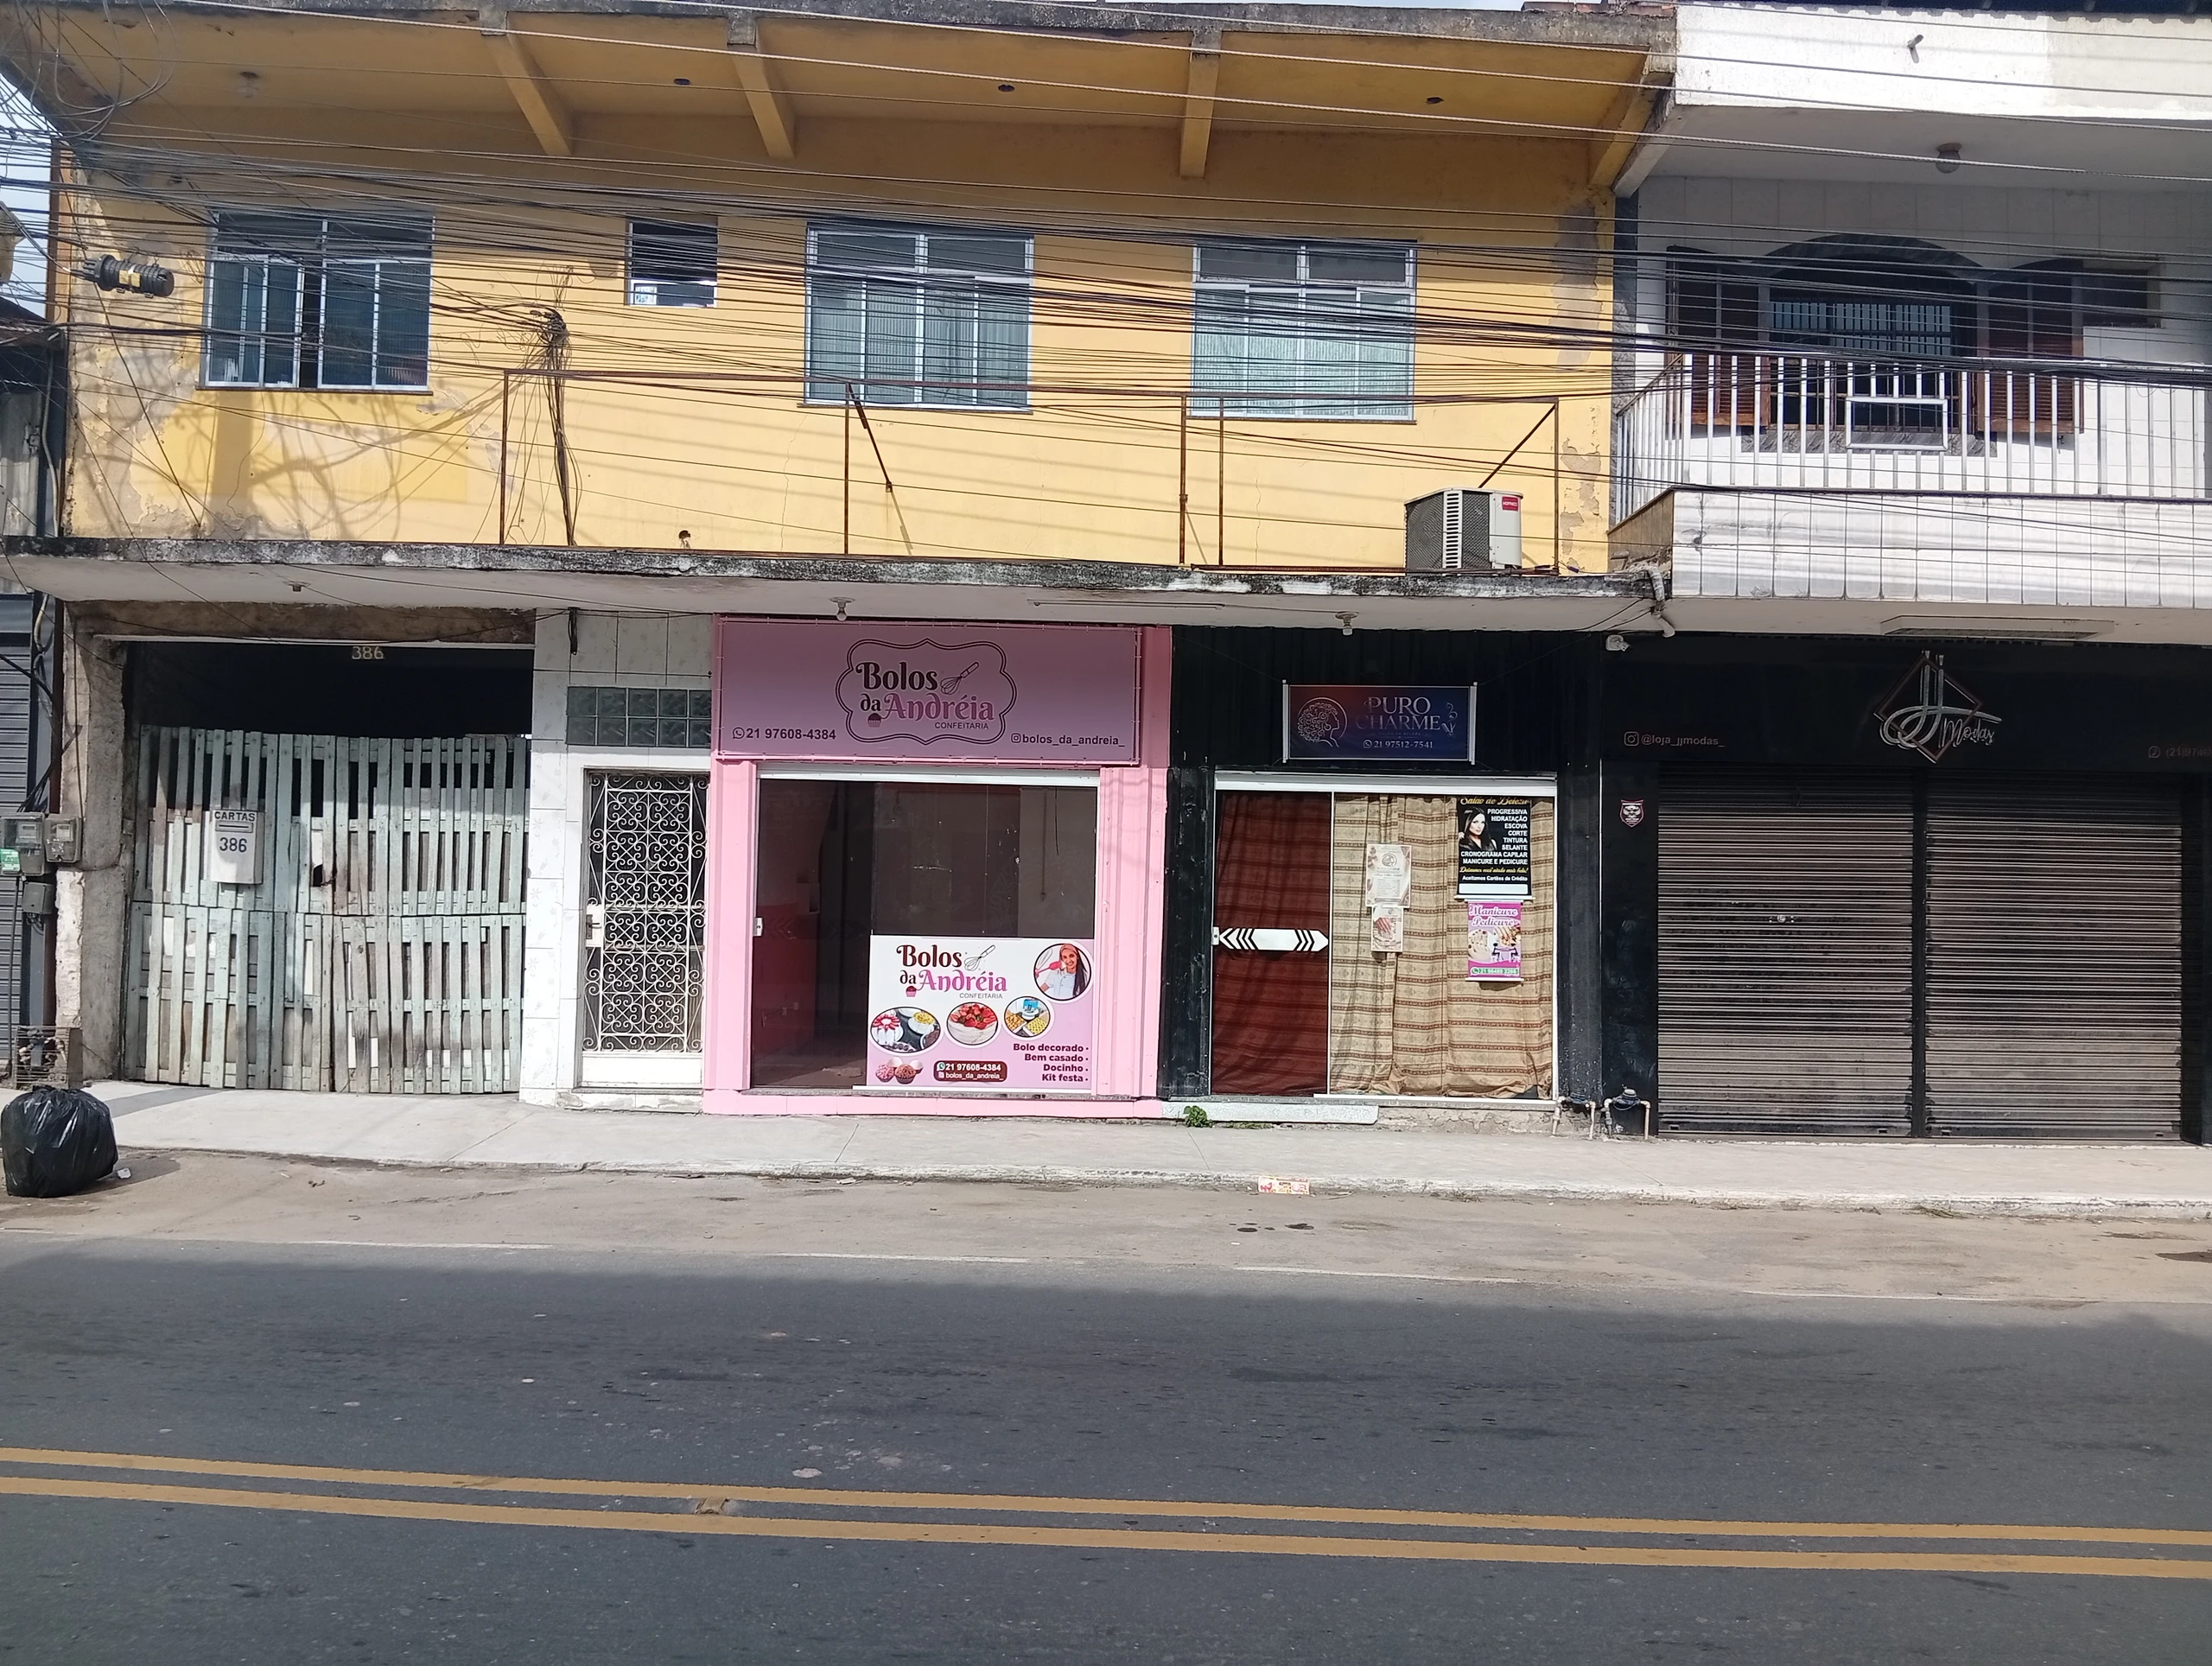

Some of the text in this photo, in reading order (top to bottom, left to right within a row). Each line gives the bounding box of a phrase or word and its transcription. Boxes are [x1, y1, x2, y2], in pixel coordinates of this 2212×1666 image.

[352, 645, 385, 660] 386
[855, 661, 938, 690] Bolos
[860, 692, 995, 722] da Andréia
[1363, 696, 1431, 715] PURO
[1356, 715, 1440, 730] CHARME
[746, 728, 836, 740] 21 97608-4384
[1022, 734, 1125, 747] bolos_da_andreia_
[214, 811, 256, 822] CARTAS
[219, 836, 248, 853] 386
[1469, 905, 1518, 916] Manicure
[1471, 916, 1514, 926] Pedicure
[896, 944, 963, 968] Bolos
[899, 969, 1007, 993] da Andréia
[1038, 1043, 1084, 1052] decorado
[957, 1063, 1001, 1071] 97608-4384
[1058, 1073, 1084, 1082] festa
